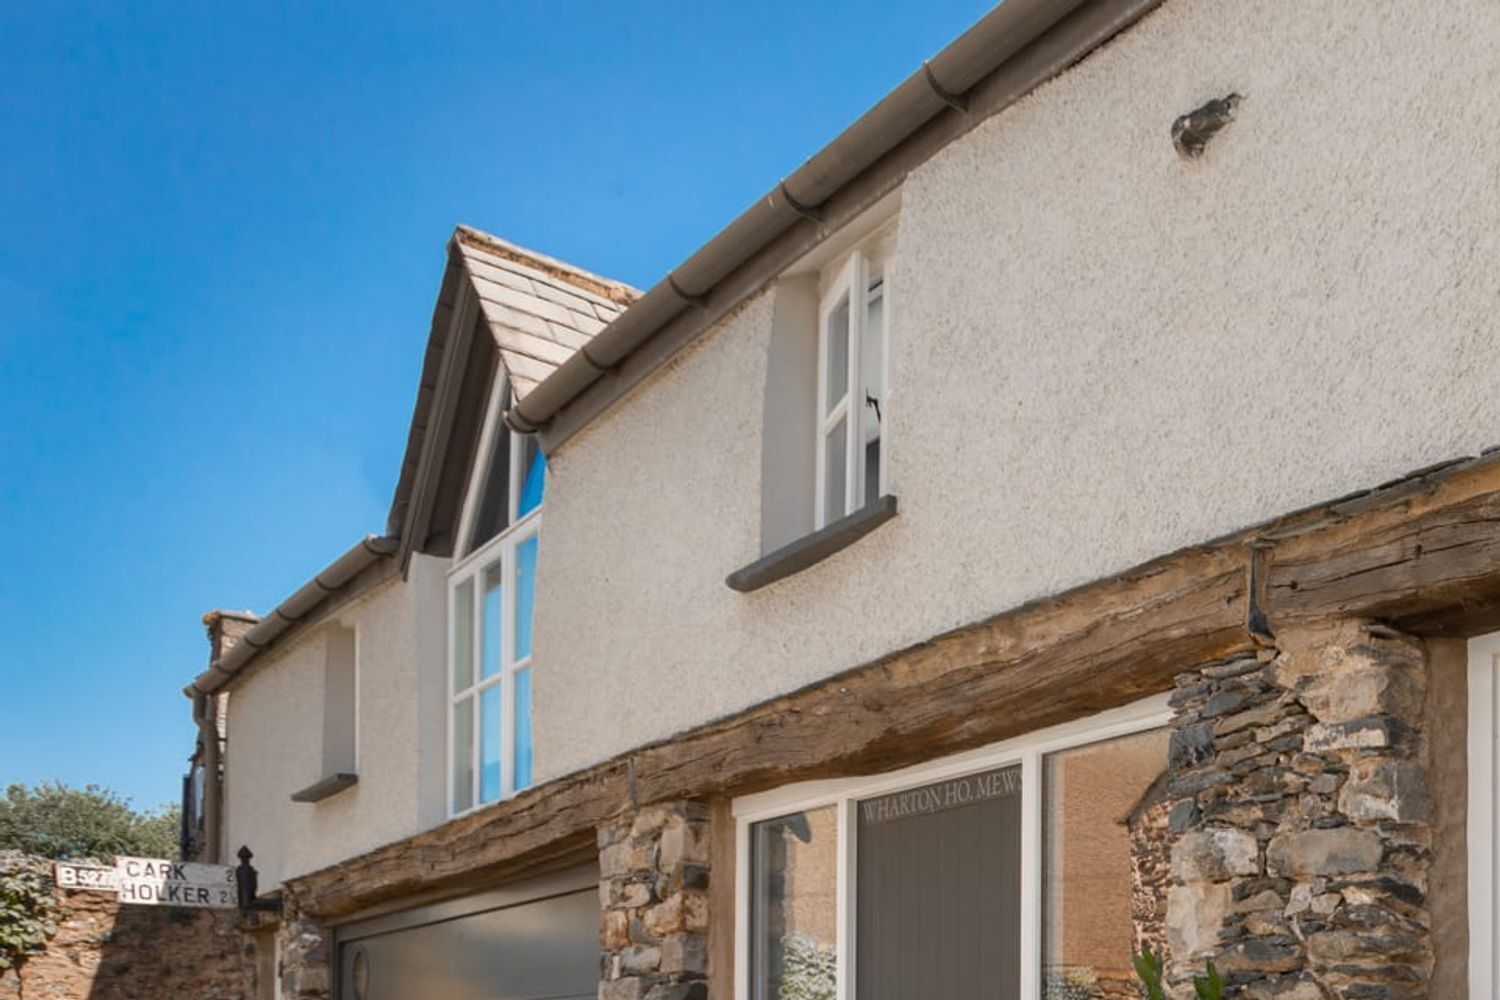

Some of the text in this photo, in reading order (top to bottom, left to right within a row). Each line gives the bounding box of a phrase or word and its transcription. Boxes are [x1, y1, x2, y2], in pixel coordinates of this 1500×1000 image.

[863, 785, 942, 823] WHARTON
[126, 861, 187, 881] CARK
[122, 884, 210, 904] HOLKER
